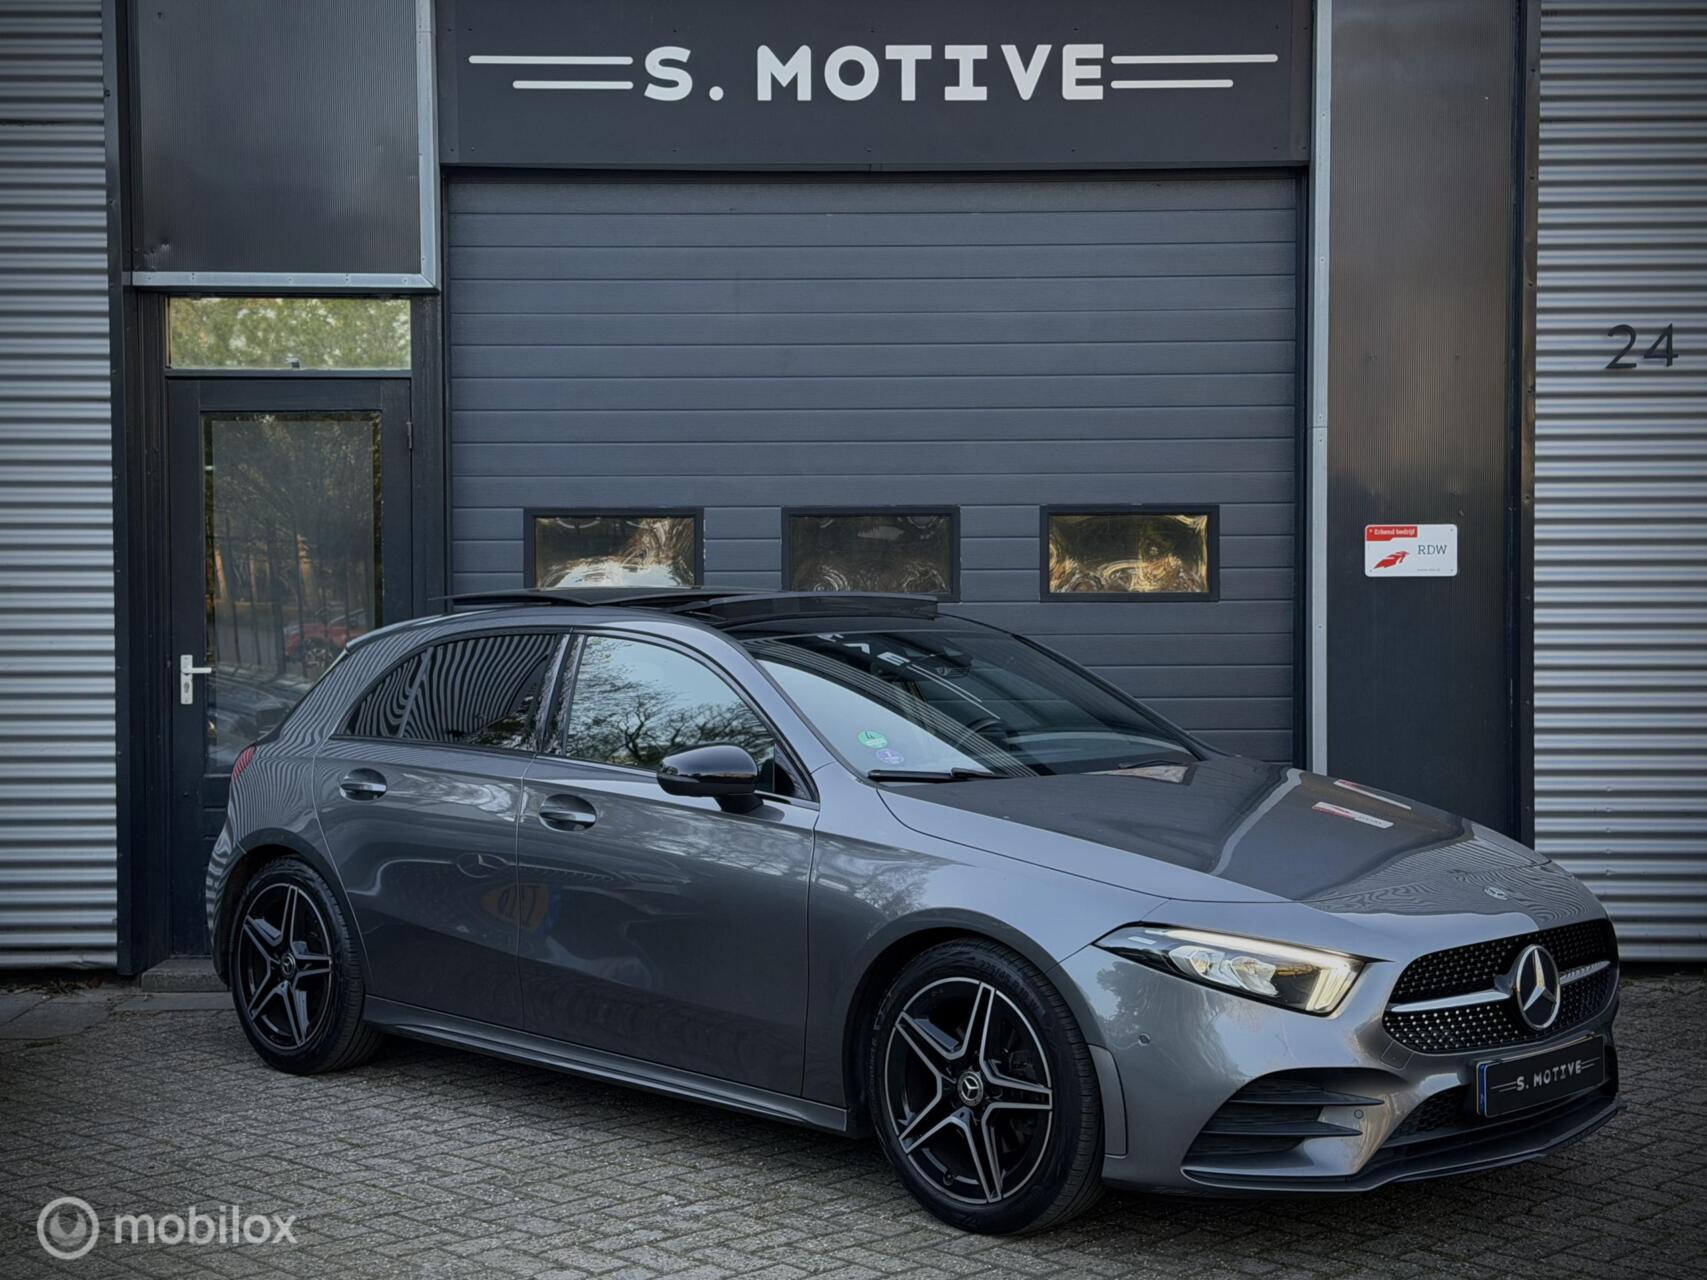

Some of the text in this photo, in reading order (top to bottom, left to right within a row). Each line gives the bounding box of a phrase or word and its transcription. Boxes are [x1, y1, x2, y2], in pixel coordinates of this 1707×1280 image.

[644, 44, 1104, 101] S. MOTIVE
[1606, 323, 1679, 369] 24
[1417, 545, 1447, 555] RDW
[1516, 1060, 1582, 1091] S. MOTIVE
